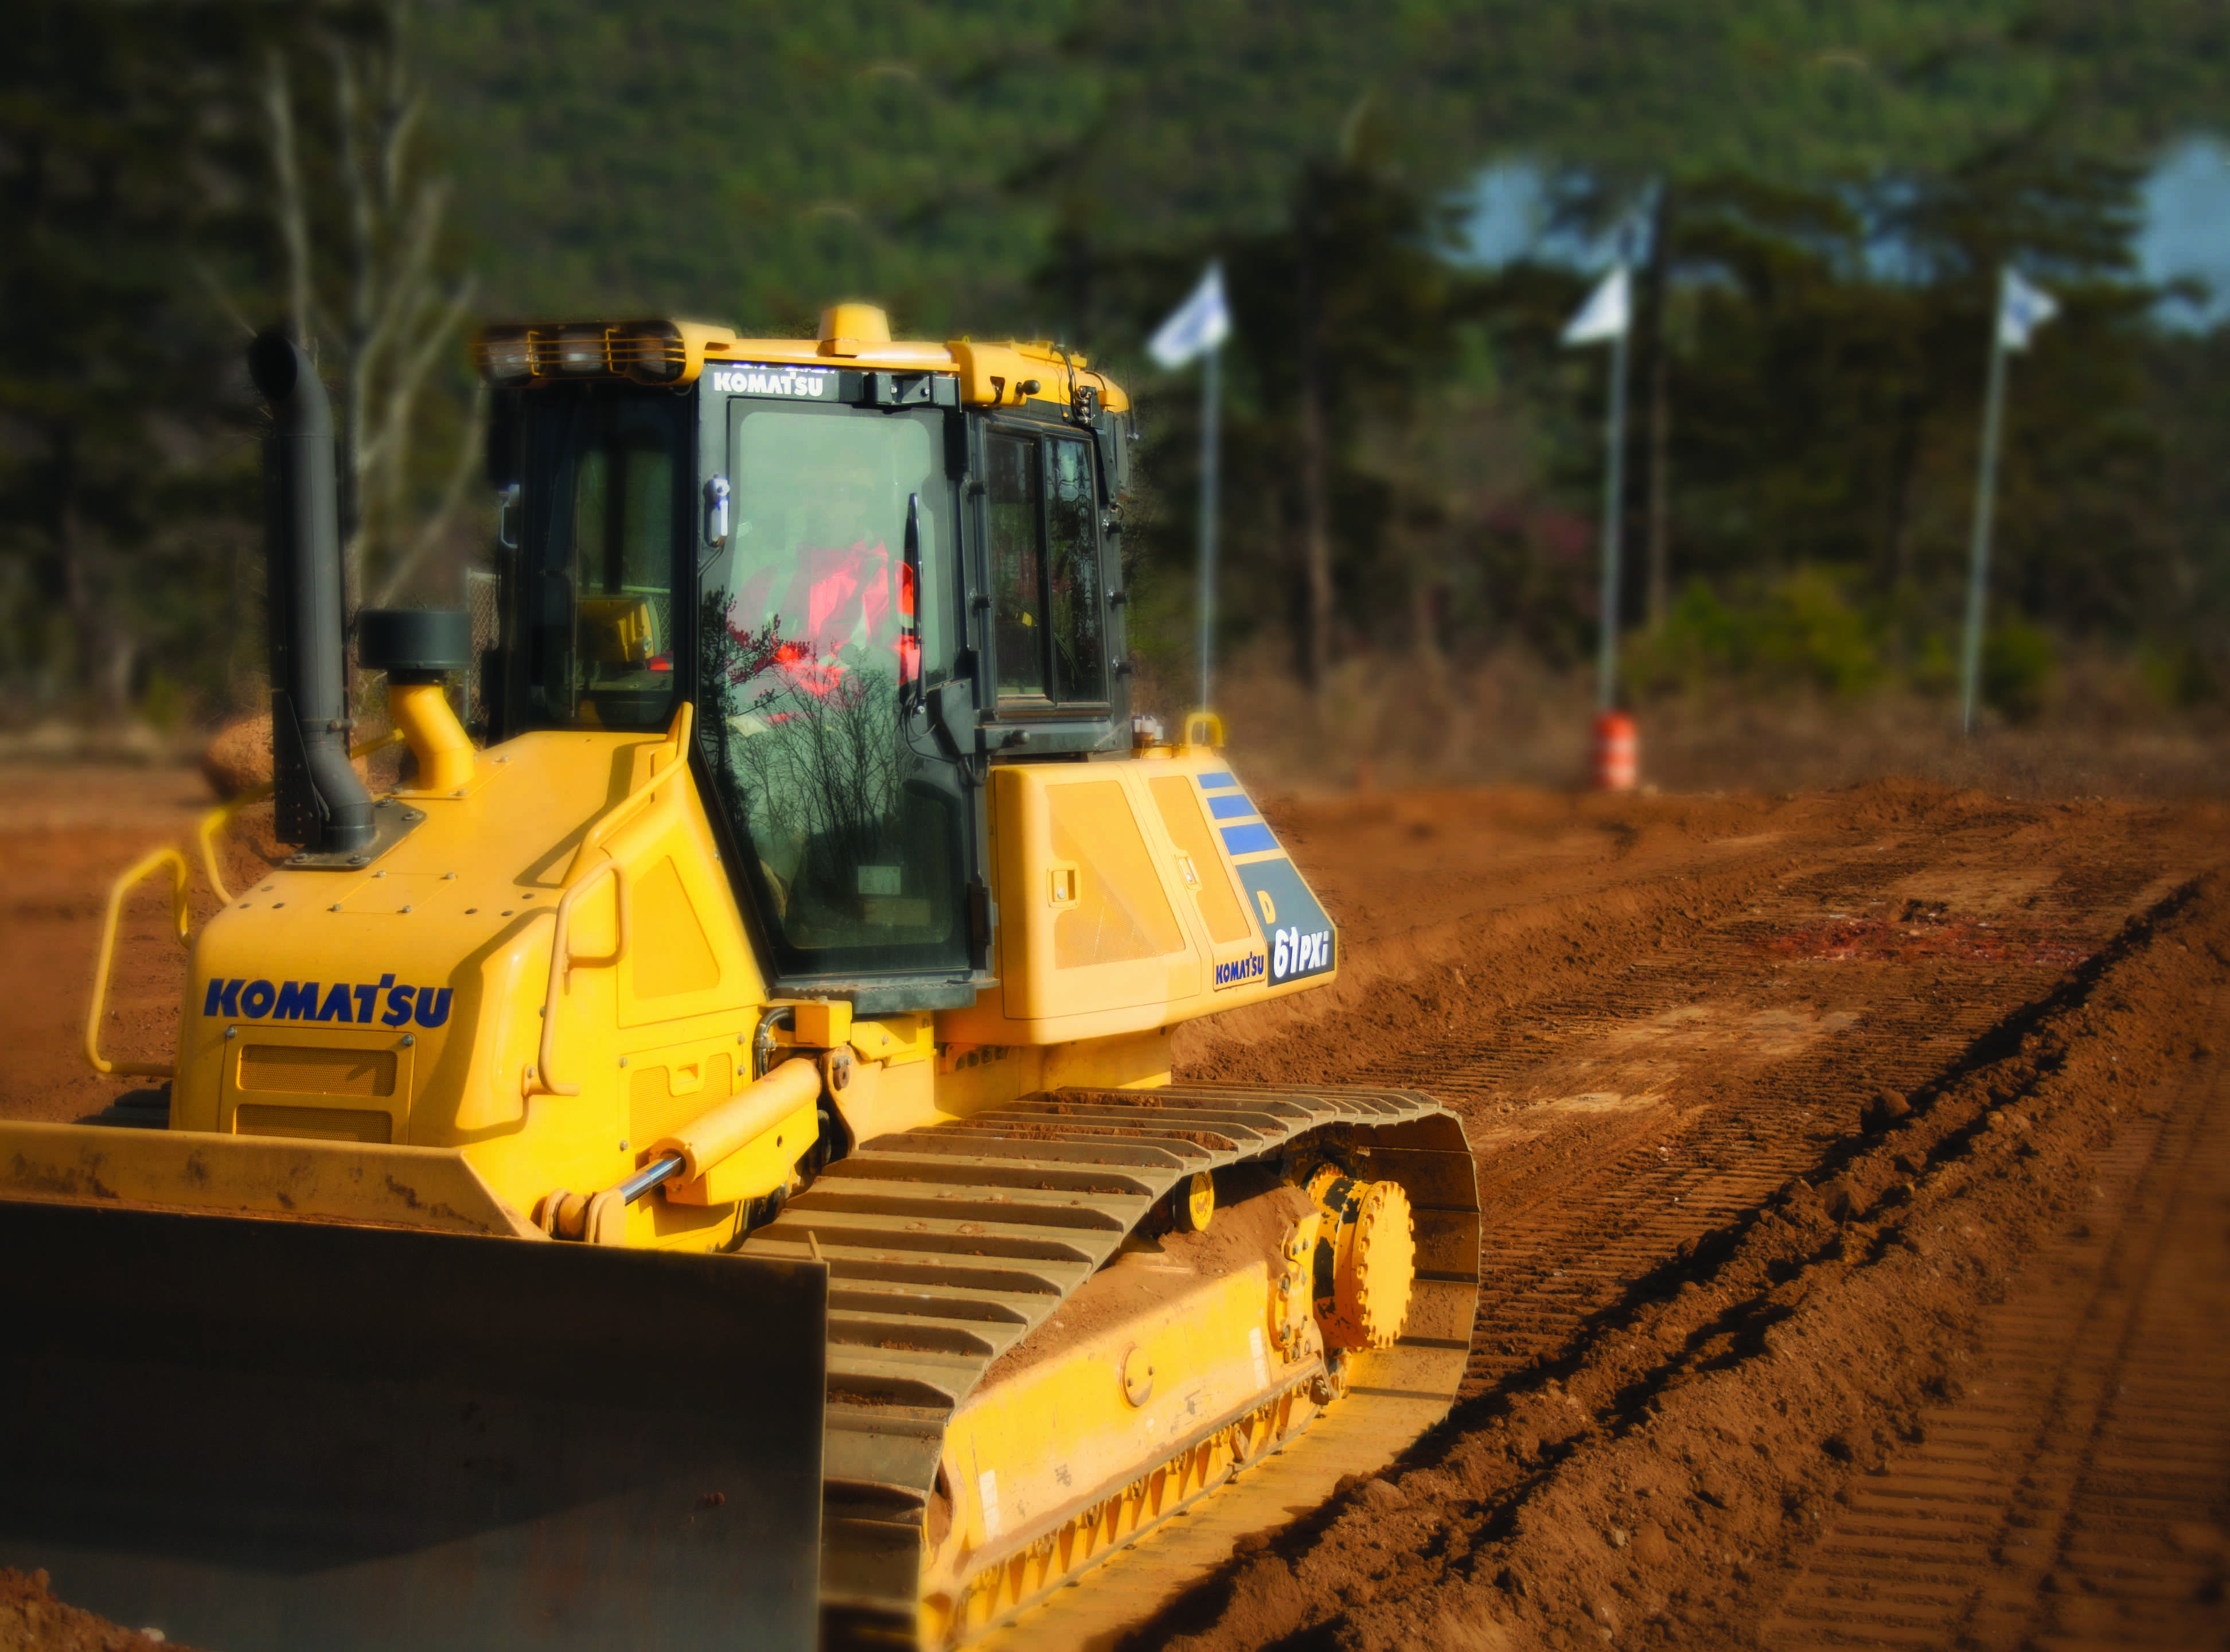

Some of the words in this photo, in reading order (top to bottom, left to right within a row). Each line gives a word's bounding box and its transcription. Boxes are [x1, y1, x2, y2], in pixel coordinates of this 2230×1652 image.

[714, 369, 822, 396] KOMATSU
[1257, 890, 1276, 924] D
[1215, 950, 1264, 985] KOMATSU
[204, 973, 454, 1028] KOMATSU
